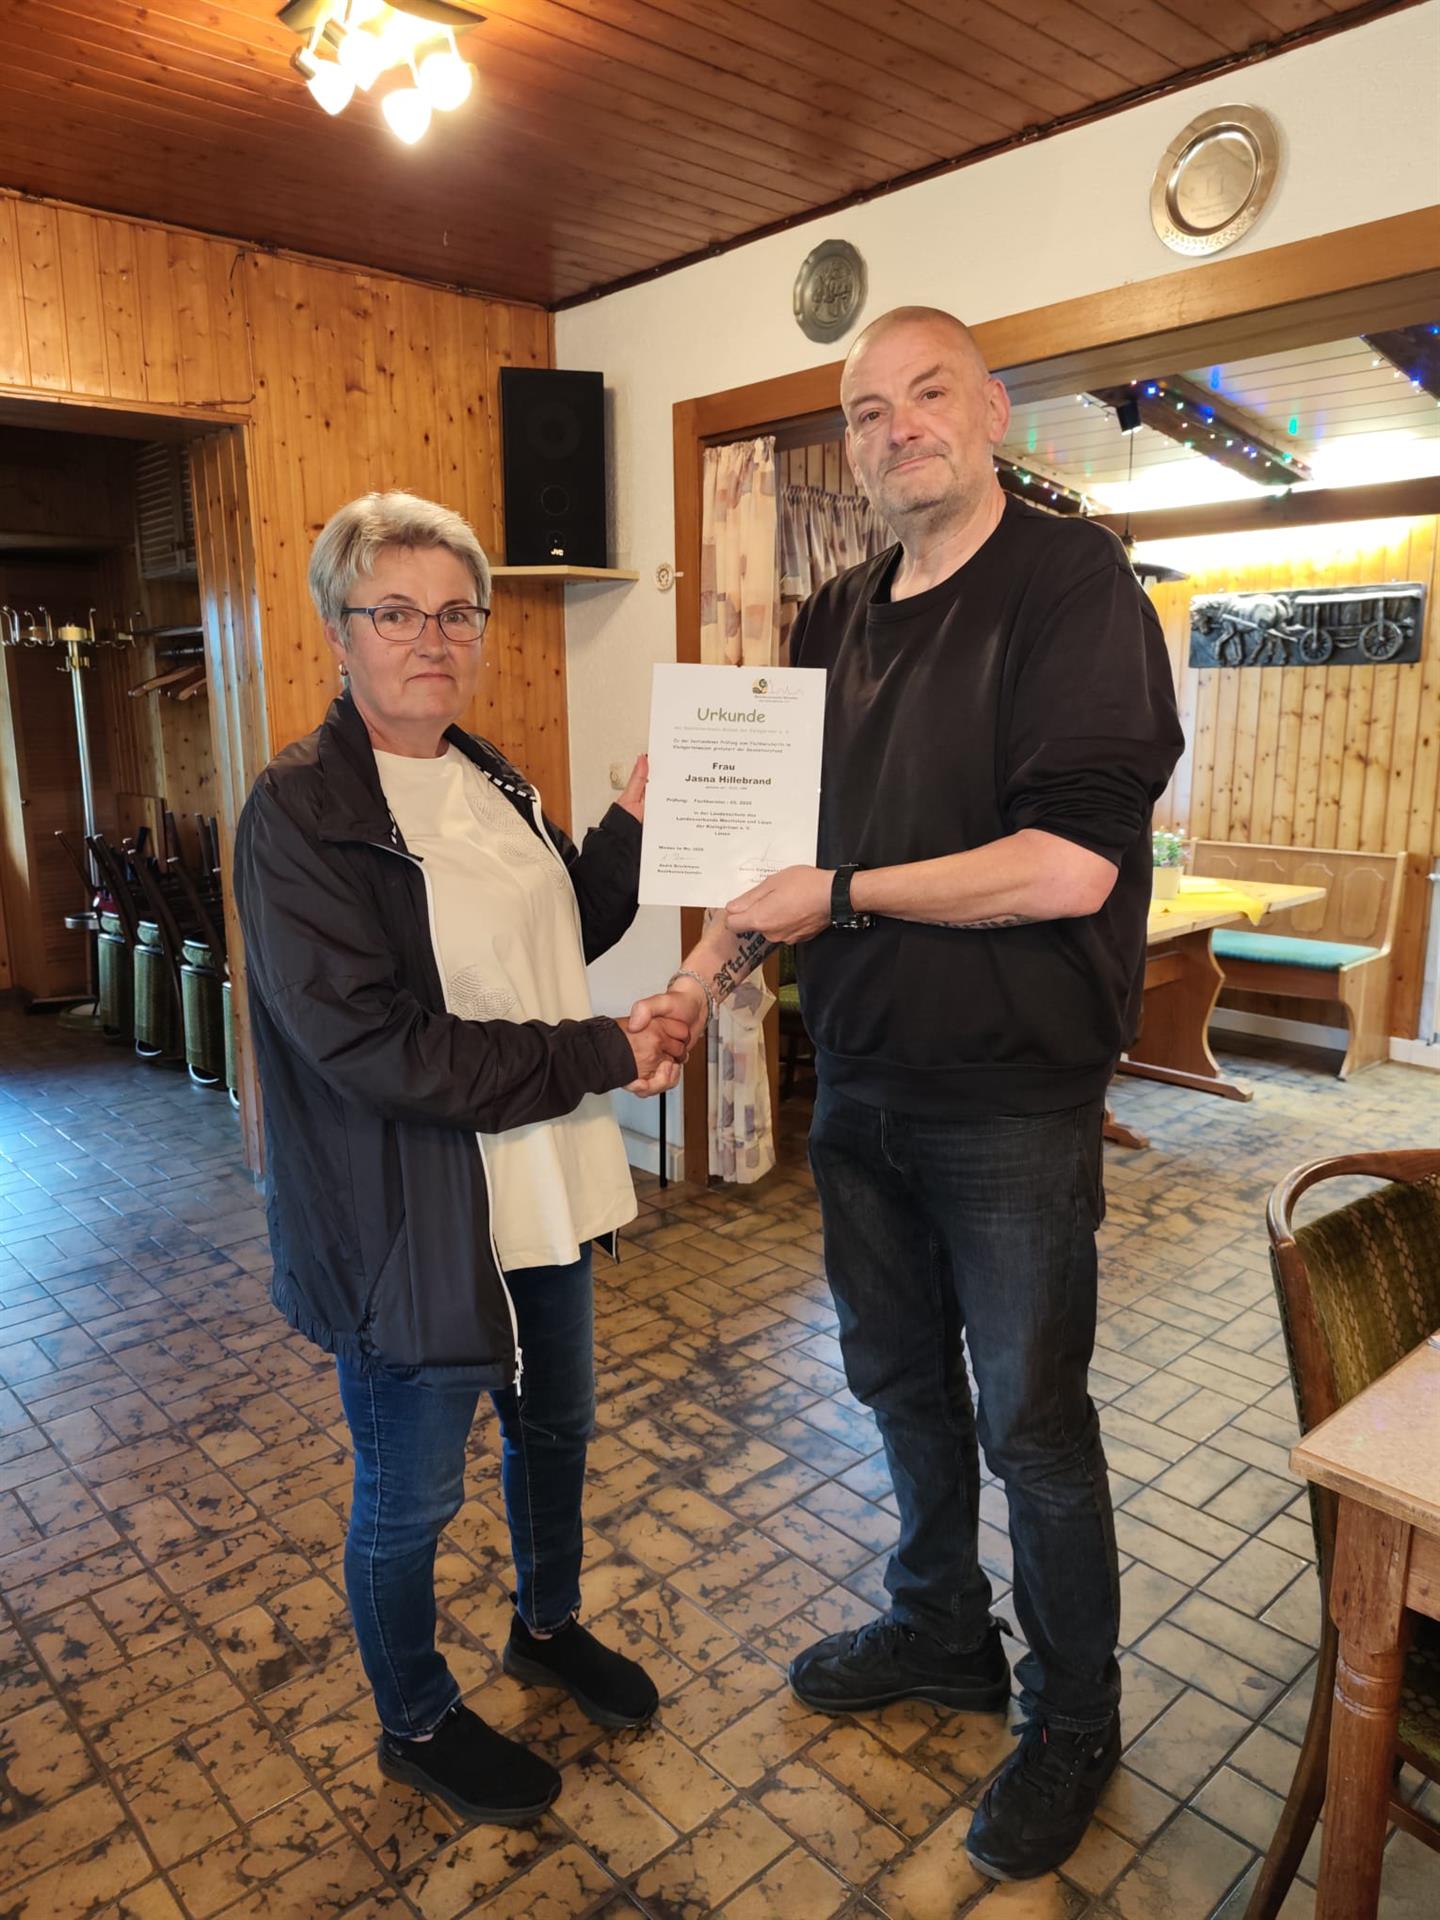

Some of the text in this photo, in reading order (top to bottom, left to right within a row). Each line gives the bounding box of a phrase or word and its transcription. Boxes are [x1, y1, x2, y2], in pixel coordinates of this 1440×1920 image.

[551, 548, 564, 556] JVC
[697, 707, 766, 723] Urkunde
[712, 762, 735, 770] Frau
[685, 774, 772, 785] Jasna Hillebrand
